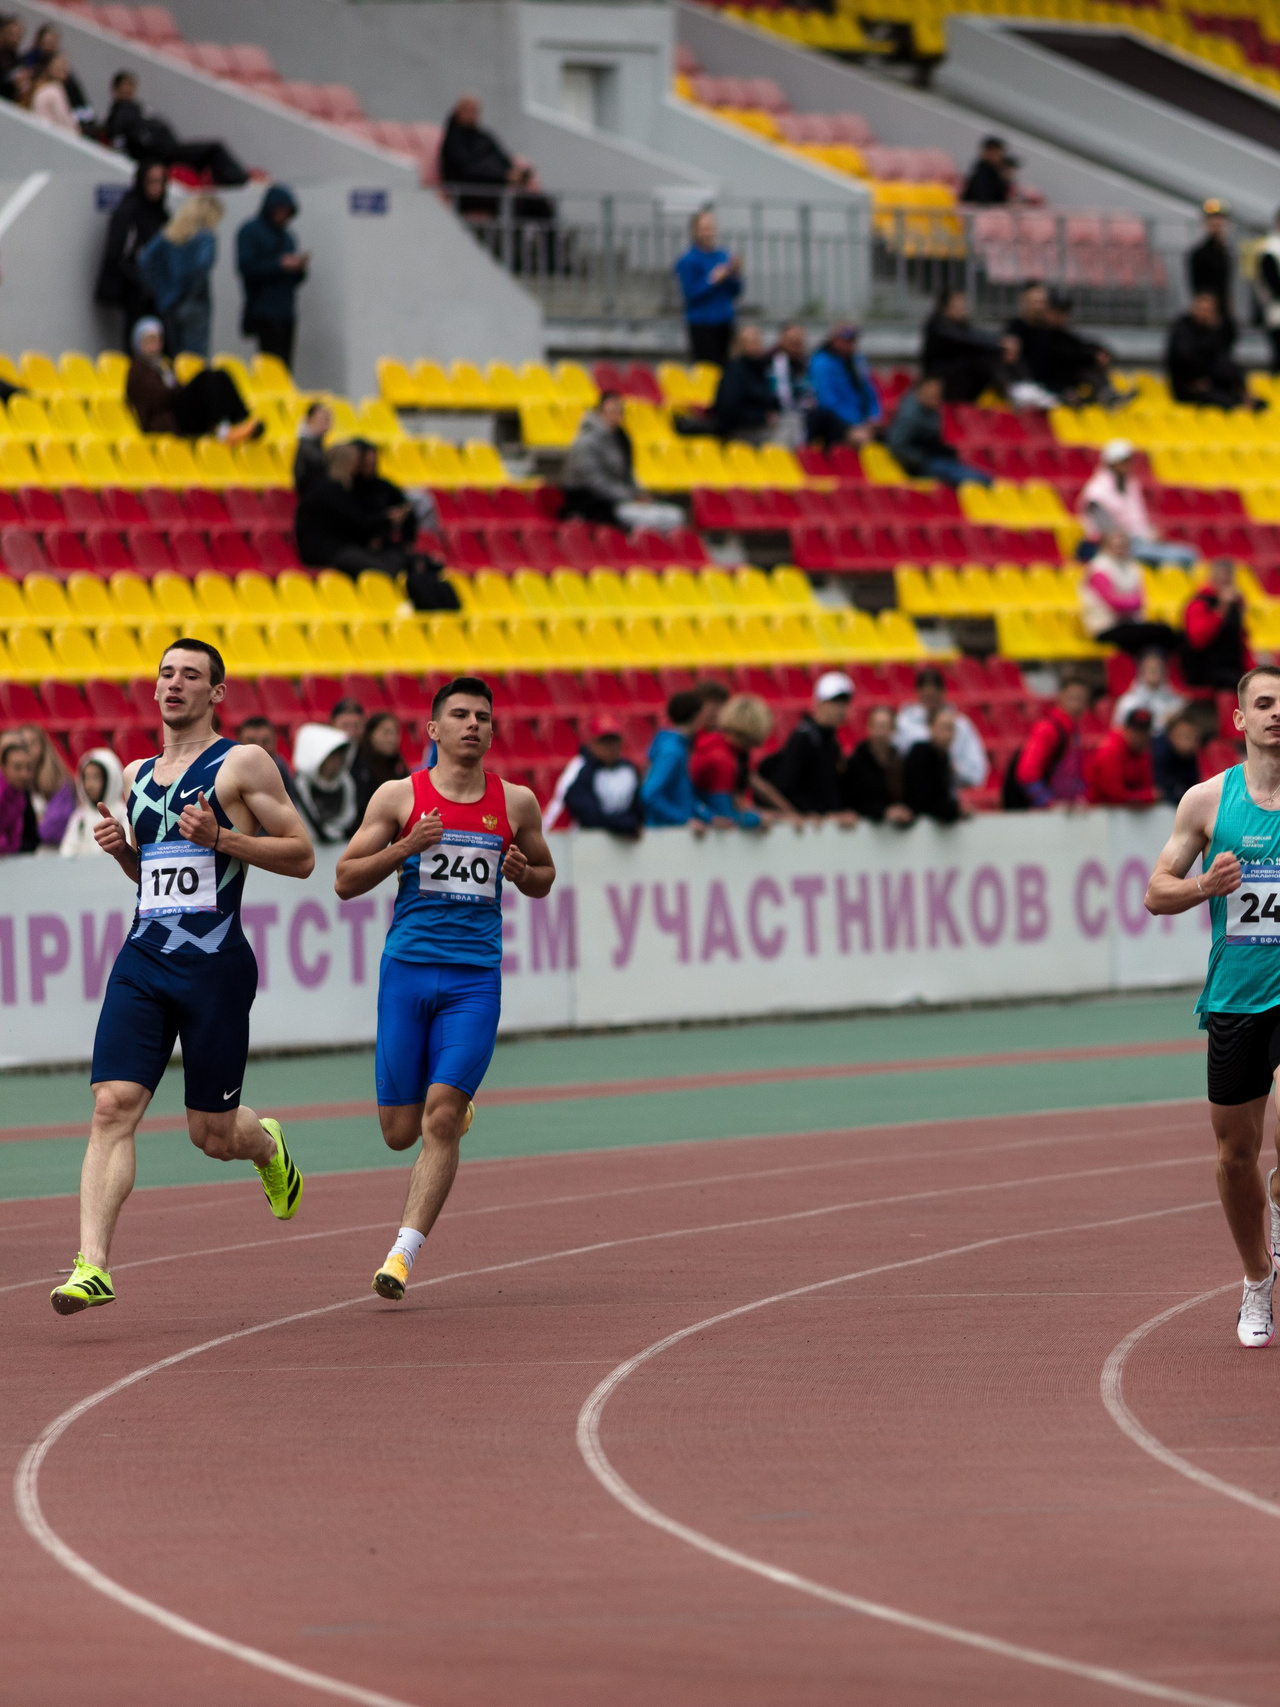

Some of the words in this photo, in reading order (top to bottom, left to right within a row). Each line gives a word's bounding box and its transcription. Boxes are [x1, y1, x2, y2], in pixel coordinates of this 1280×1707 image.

[151, 866, 200, 896] 170
[430, 853, 490, 885] 240
[605, 863, 1050, 969] УЧАСТНИКОВ
